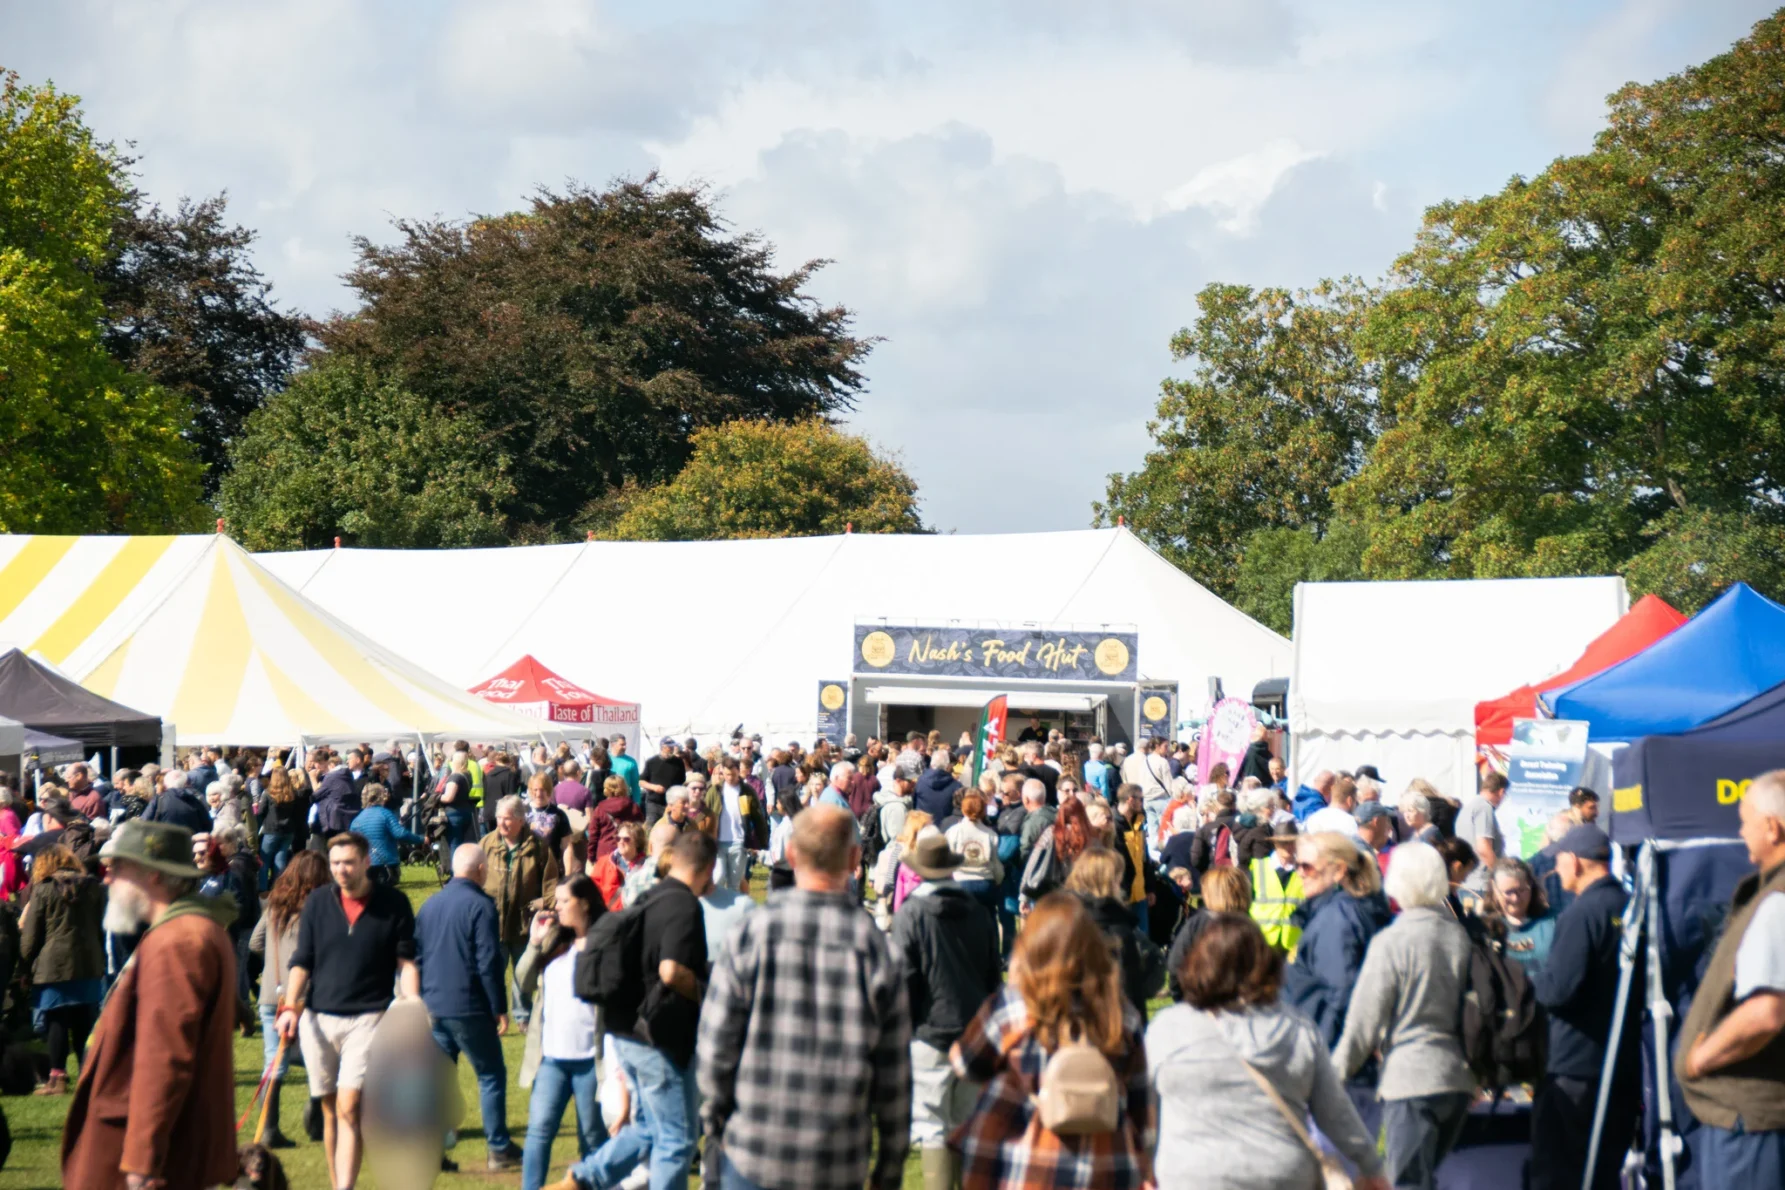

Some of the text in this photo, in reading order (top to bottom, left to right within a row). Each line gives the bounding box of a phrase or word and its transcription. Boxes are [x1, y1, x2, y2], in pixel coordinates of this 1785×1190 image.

[908, 634, 1088, 671] Nash's Food Hut
[552, 703, 638, 722] Taste of Thailand
